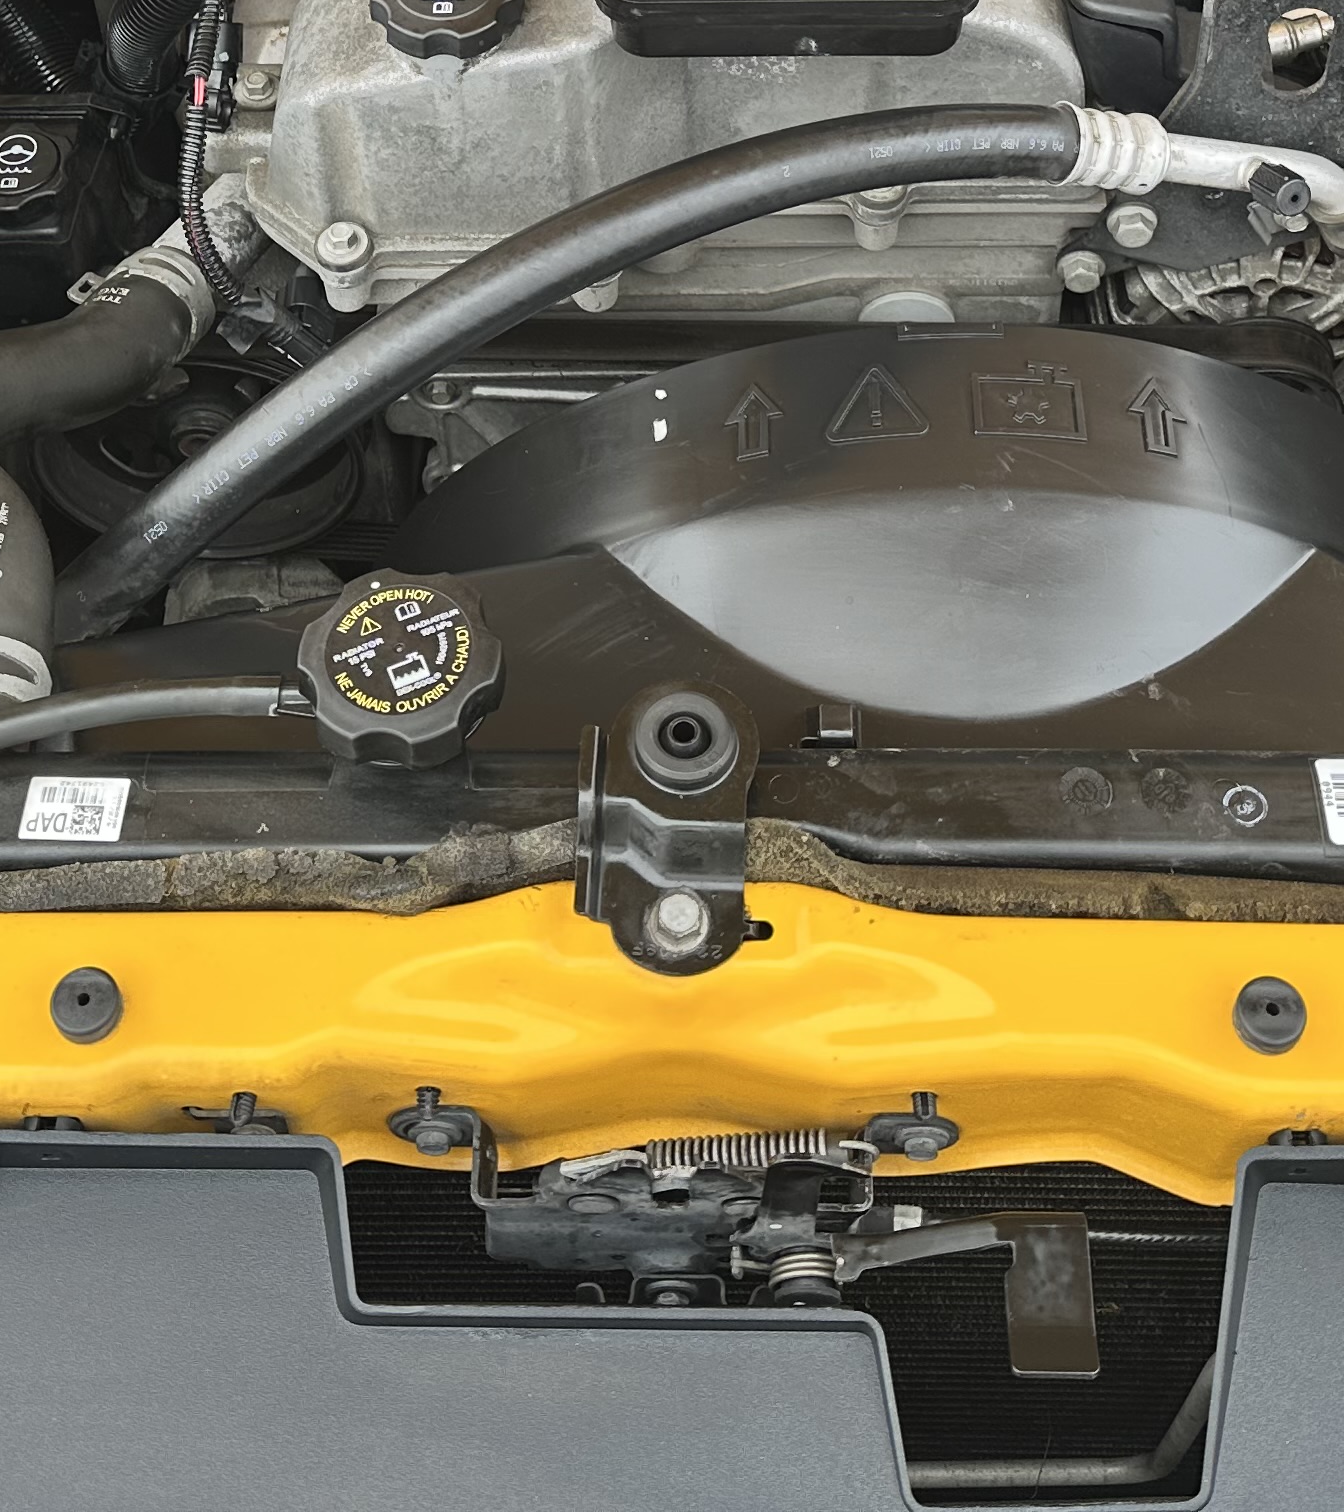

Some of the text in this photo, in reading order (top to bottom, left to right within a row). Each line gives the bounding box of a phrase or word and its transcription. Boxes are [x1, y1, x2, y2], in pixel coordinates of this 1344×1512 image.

[869, 146, 893, 159] 0521
[937, 138, 961, 152] CIIR
[972, 137, 991, 149] PET
[1000, 138, 1019, 149] NBR
[1029, 138, 1047, 150] 6.6
[1052, 141, 1064, 152] PA
[97, 287, 130, 296] ENG
[295, 405, 315, 425] 6.6
[265, 426, 288, 447] NBR
[237, 448, 260, 470] PET
[202, 470, 230, 496] CIIR
[143, 520, 168, 544] 0521
[336, 589, 434, 634] NEVER OPEN HOT!
[406, 608, 460, 633] RADIATEUR
[332, 638, 384, 663] RADIATOR
[451, 625, 470, 673] CHAUD!
[334, 671, 350, 692] NE
[446, 674, 460, 685] A
[347, 686, 391, 713] JAMAIS
[396, 683, 450, 713] OUVRIR
[26, 812, 67, 832] DAP
